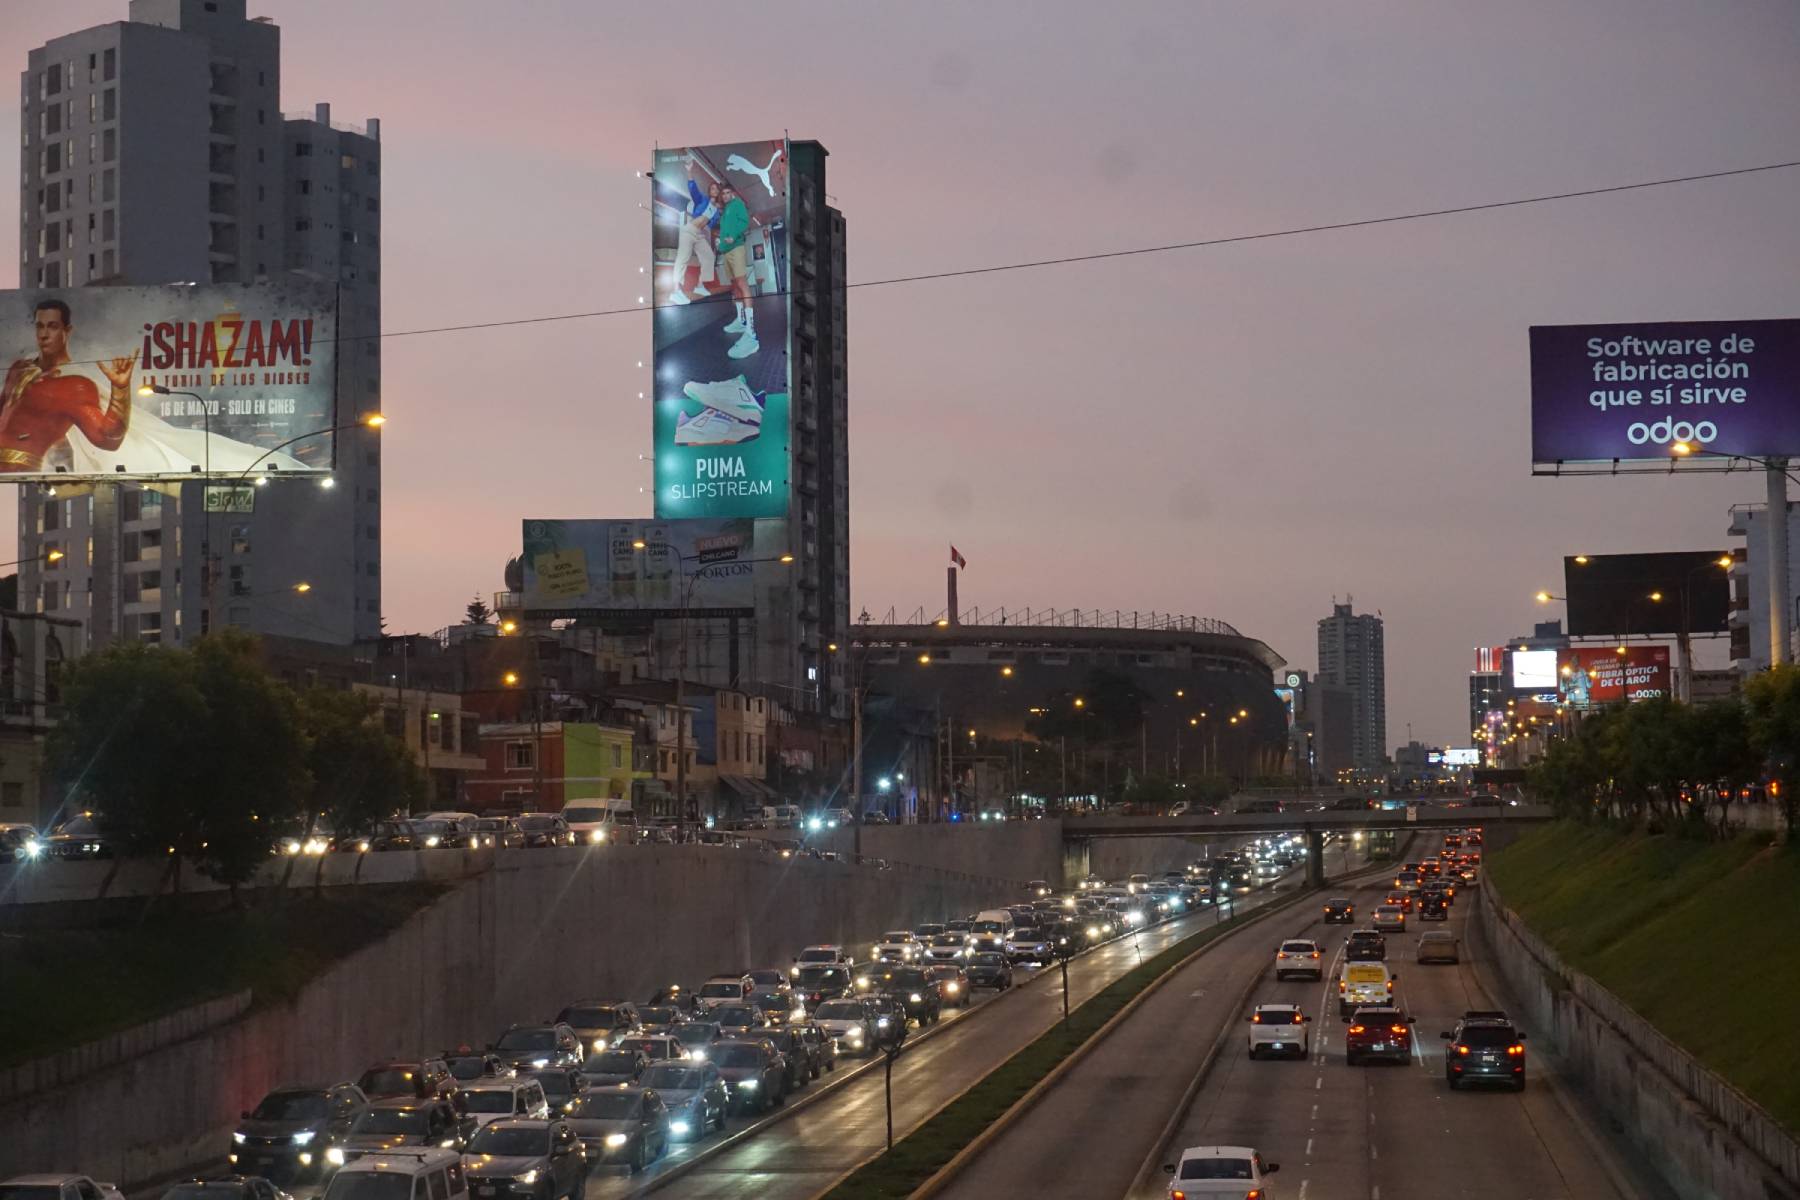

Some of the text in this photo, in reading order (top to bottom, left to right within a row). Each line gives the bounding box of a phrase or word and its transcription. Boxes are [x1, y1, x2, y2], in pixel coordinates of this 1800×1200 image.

[142, 319, 314, 370] ¡SHAZAM!
[1586, 333, 1756, 358] Software de
[233, 373, 255, 386] LOS
[1592, 357, 1749, 382] fabricación
[160, 402, 172, 416] 16
[173, 401, 184, 415] DE
[187, 400, 219, 416] MARZO
[228, 399, 254, 415] SOLO
[254, 398, 268, 414] EN
[269, 397, 296, 414] CINES
[1589, 382, 1747, 411] que sí sirve
[1627, 415, 1718, 445] odoo
[696, 456, 746, 479] PUMA
[671, 480, 773, 499] SLIPSTREAM
[1597, 669, 1624, 679] FIBRA
[1601, 679, 1613, 687] DE
